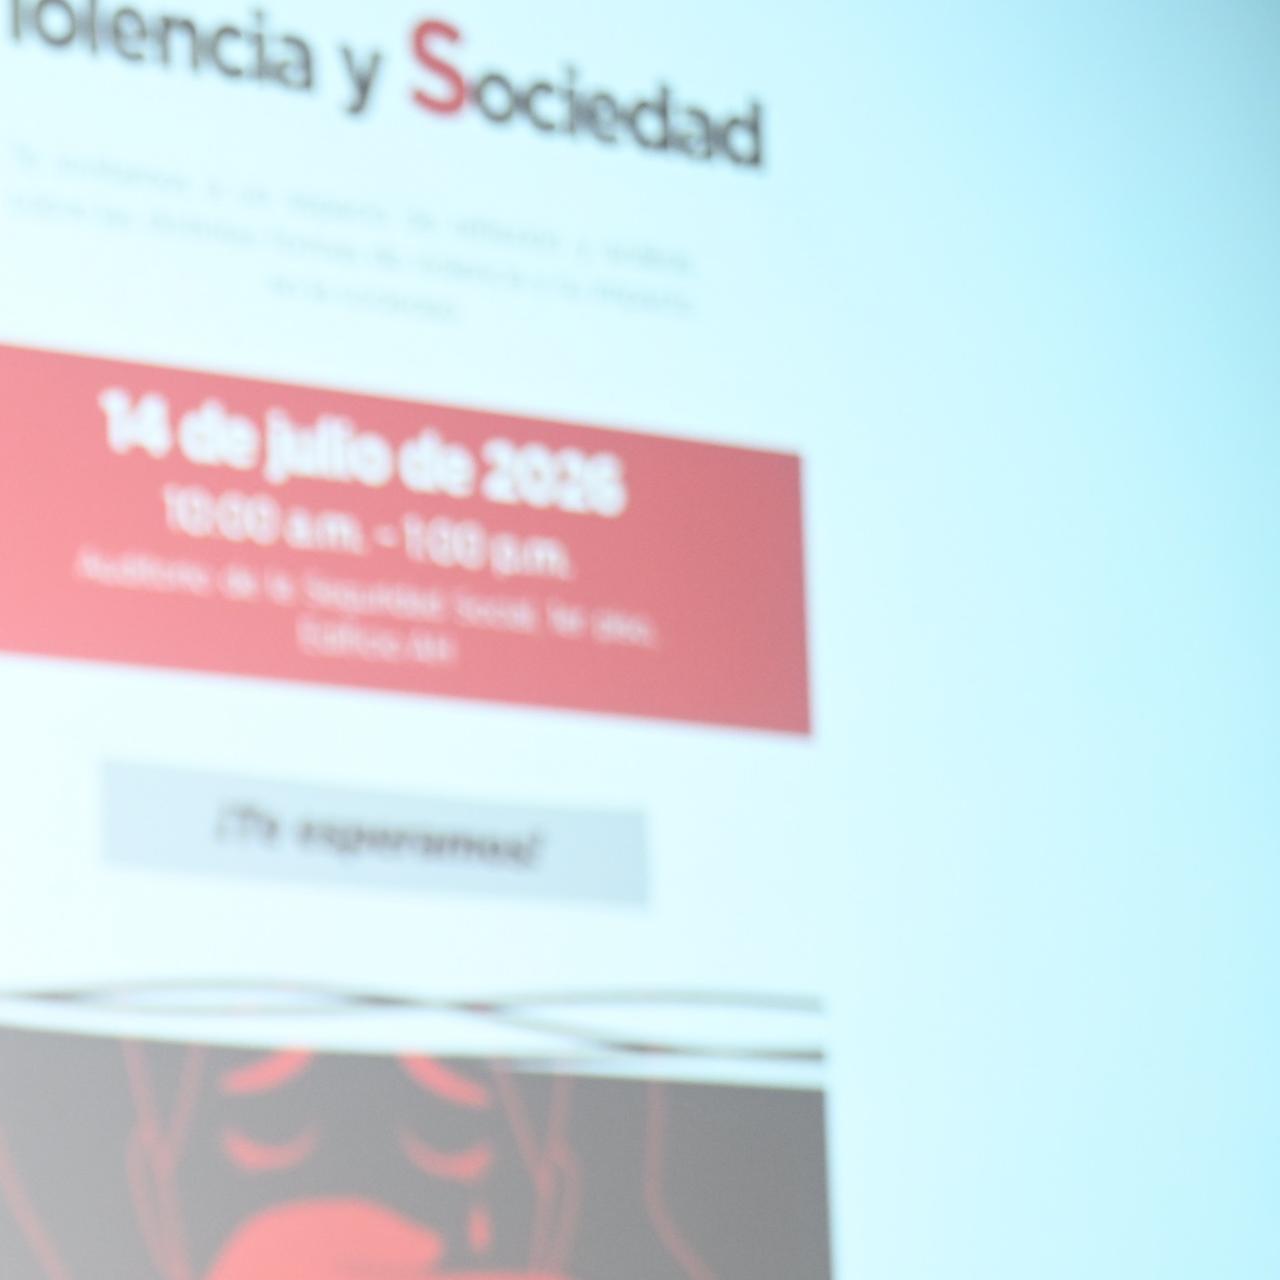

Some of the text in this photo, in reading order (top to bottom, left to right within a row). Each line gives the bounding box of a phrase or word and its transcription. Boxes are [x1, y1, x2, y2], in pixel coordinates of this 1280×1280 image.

[338, 44, 383, 115] y
[410, 18, 767, 169] Sociedad
[98, 389, 627, 517] 14 de julio de 2026
